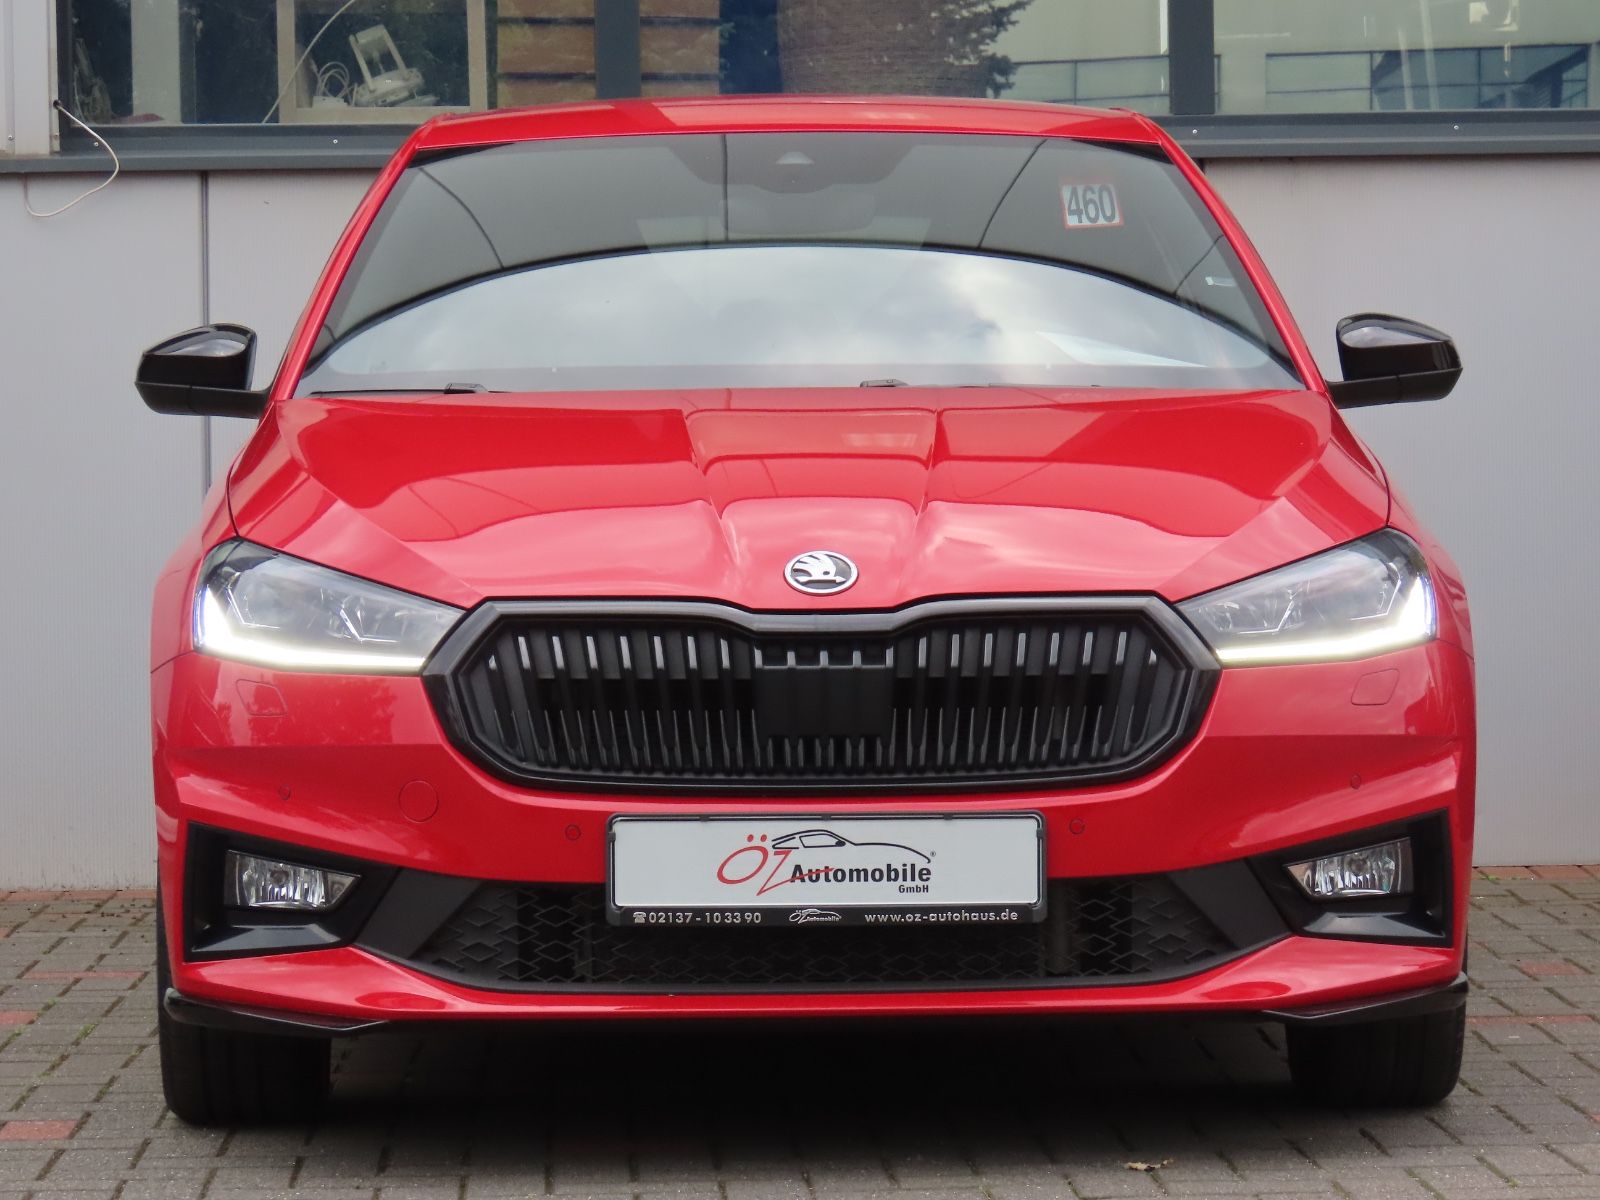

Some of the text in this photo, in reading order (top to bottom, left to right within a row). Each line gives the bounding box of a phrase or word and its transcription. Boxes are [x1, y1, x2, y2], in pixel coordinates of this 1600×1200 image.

[1067, 185, 1116, 224] 460
[790, 864, 932, 883] Automobile
[898, 884, 930, 894] GmbH
[648, 911, 693, 924] 02137
[864, 909, 1019, 923] www.oz-autohaus.de
